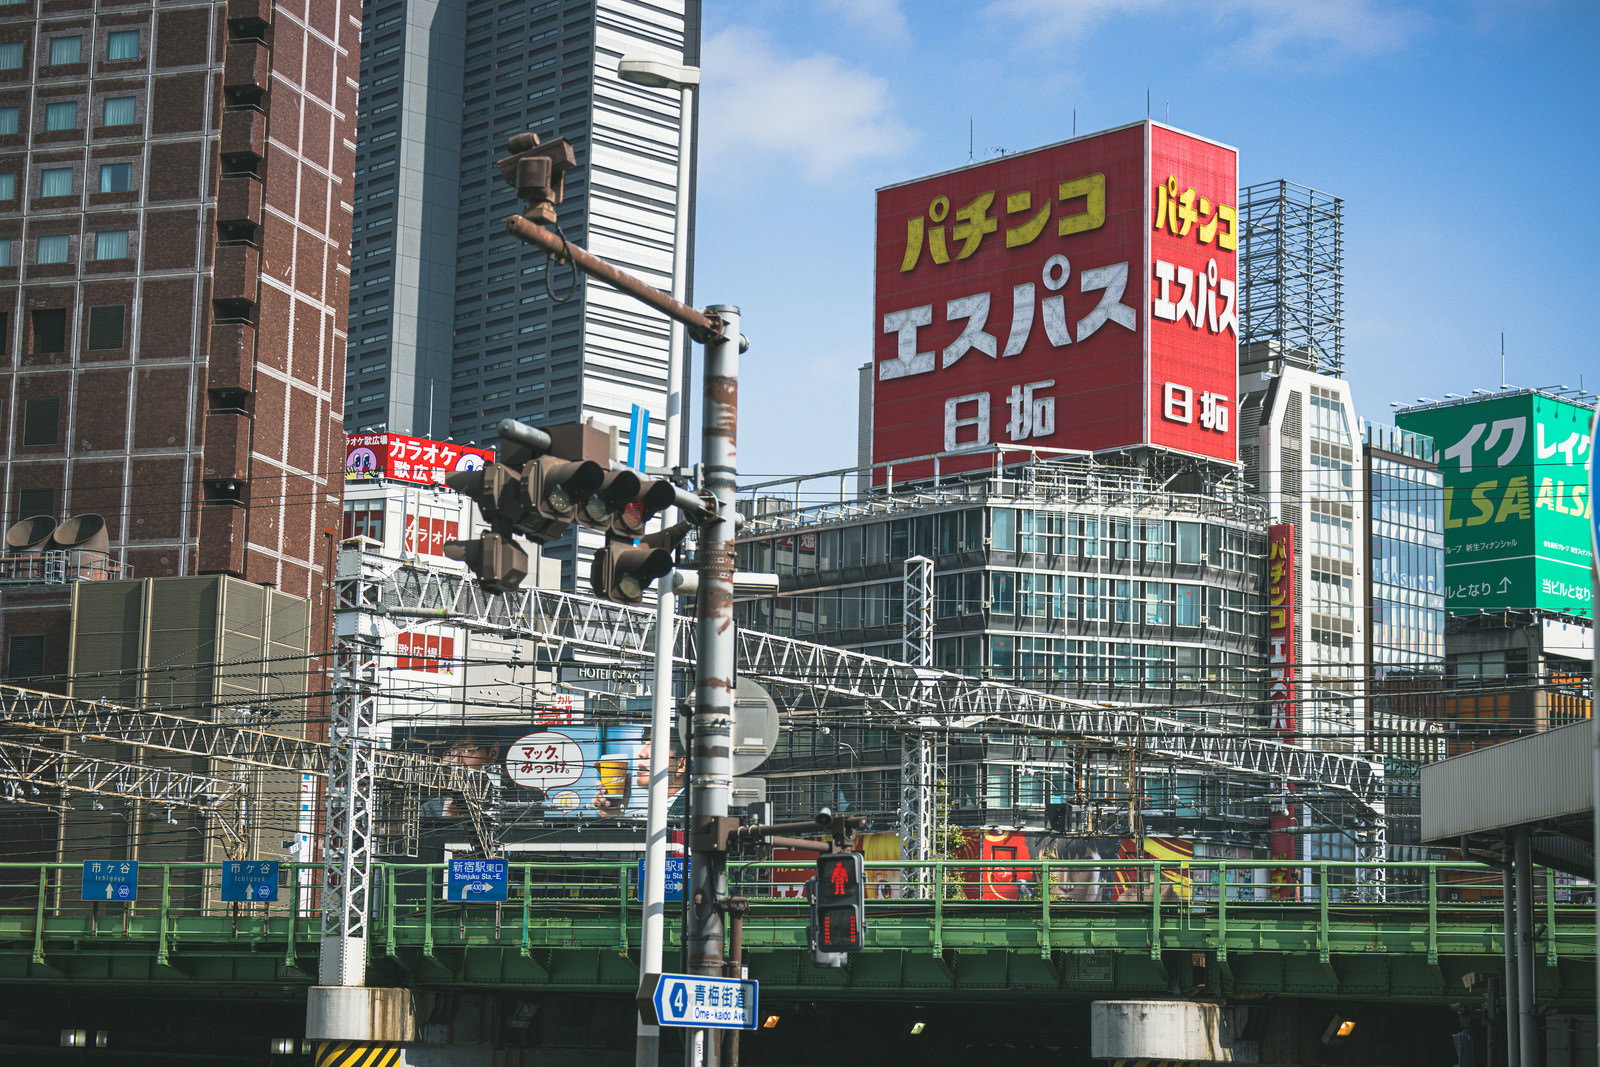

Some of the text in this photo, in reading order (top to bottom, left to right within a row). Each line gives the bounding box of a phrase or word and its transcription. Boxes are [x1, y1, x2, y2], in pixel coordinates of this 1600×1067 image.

[899, 172, 1106, 273] パチンコ
[1154, 174, 1237, 251] パチンコ
[1154, 257, 1238, 336] エスパス
[879, 254, 1137, 382] エスパス
[943, 379, 1056, 452] 日拓
[1163, 381, 1229, 433] 日拓
[389, 437, 457, 467] カラオケ
[393, 460, 446, 485] 歌広場
[1270, 537, 1287, 630] パチンコ
[579, 667, 610, 680] HOTEL
[521, 745, 559, 760] マック、
[453, 861, 504, 873] 新宿駅東口
[454, 873, 480, 881] Shinjuku
[674, 988, 684, 1012] 4
[694, 984, 746, 1009] 青梅街道
